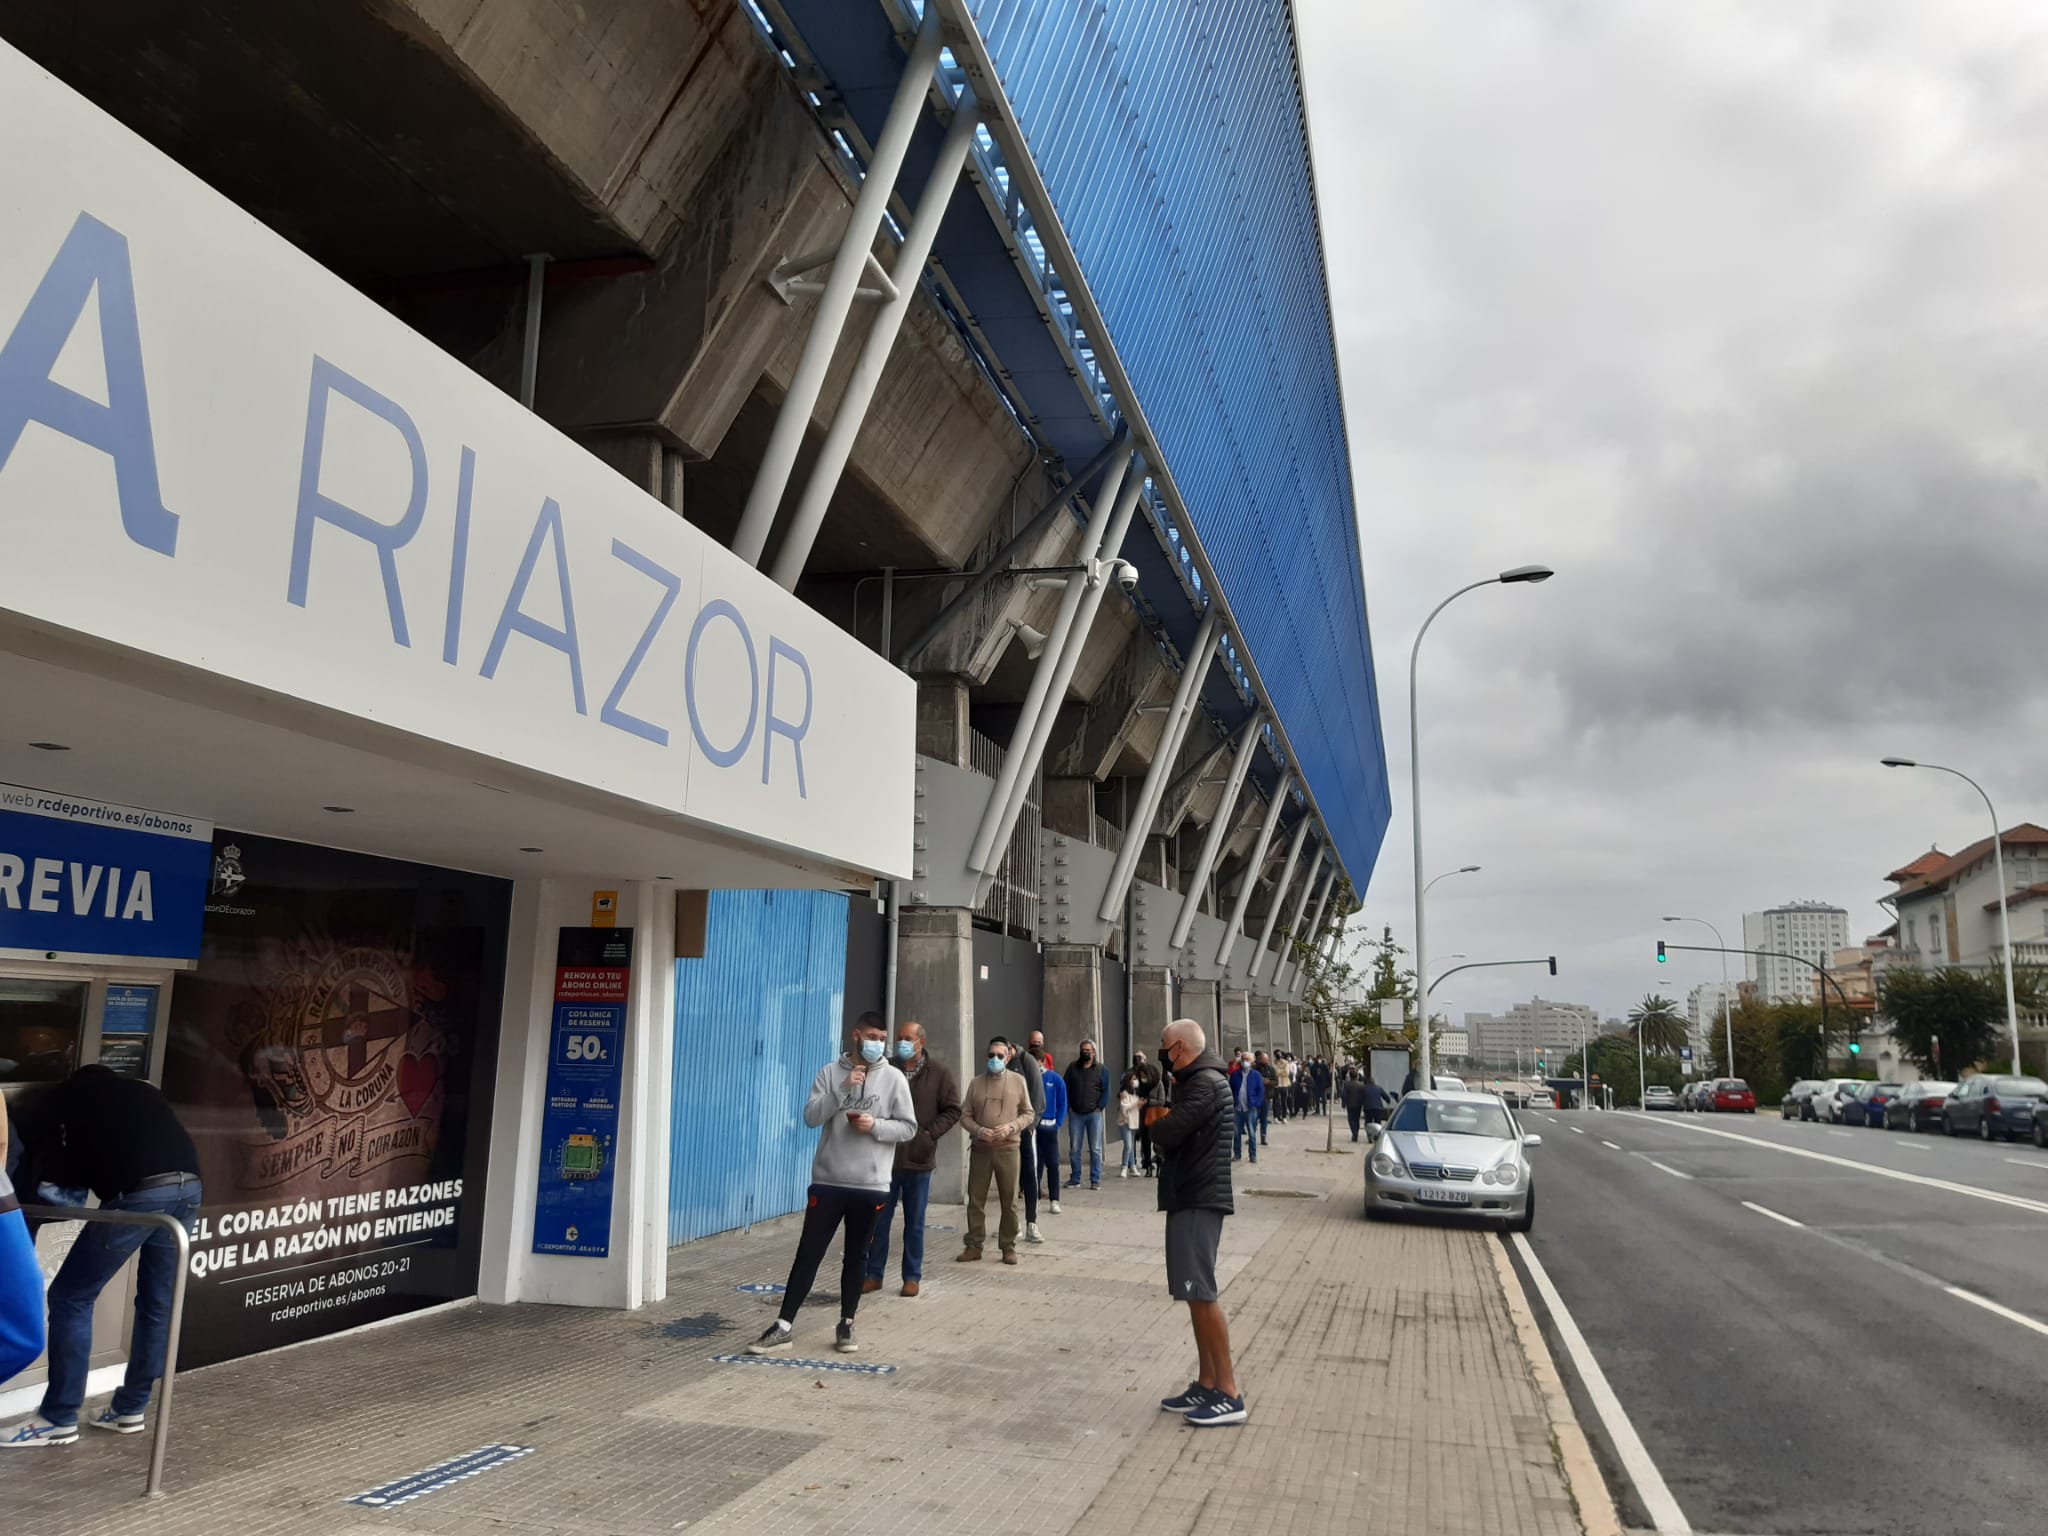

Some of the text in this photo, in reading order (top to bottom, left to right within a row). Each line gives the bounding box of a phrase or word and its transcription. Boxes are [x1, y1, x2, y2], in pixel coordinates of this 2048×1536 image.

[287, 353, 814, 799] RIAZOR
[2, 790, 193, 834] web rcdeportivo.es/abonos
[562, 981, 622, 990] ABONO ONLINE
[564, 972, 622, 980] RENOVA O TEU
[568, 1010, 587, 1018] COTA
[578, 1019, 611, 1027] RESERVA
[339, 1090, 351, 1108] LA
[258, 1131, 325, 1179] SEMPRE
[337, 1129, 356, 1159] NO
[217, 1197, 322, 1237] CORAZÓN
[328, 1190, 381, 1218] TIENE
[385, 1178, 464, 1209] RAZONES
[1423, 1189, 1446, 1200] 1212
[190, 1206, 456, 1277] QUE LA RAZÓN NO ENTIENDE
[245, 1281, 305, 1308] RESERVA
[308, 1277, 325, 1292] DE
[329, 1265, 379, 1289] ABONOS
[270, 1284, 387, 1323] rcdeportivo.es/abonos
